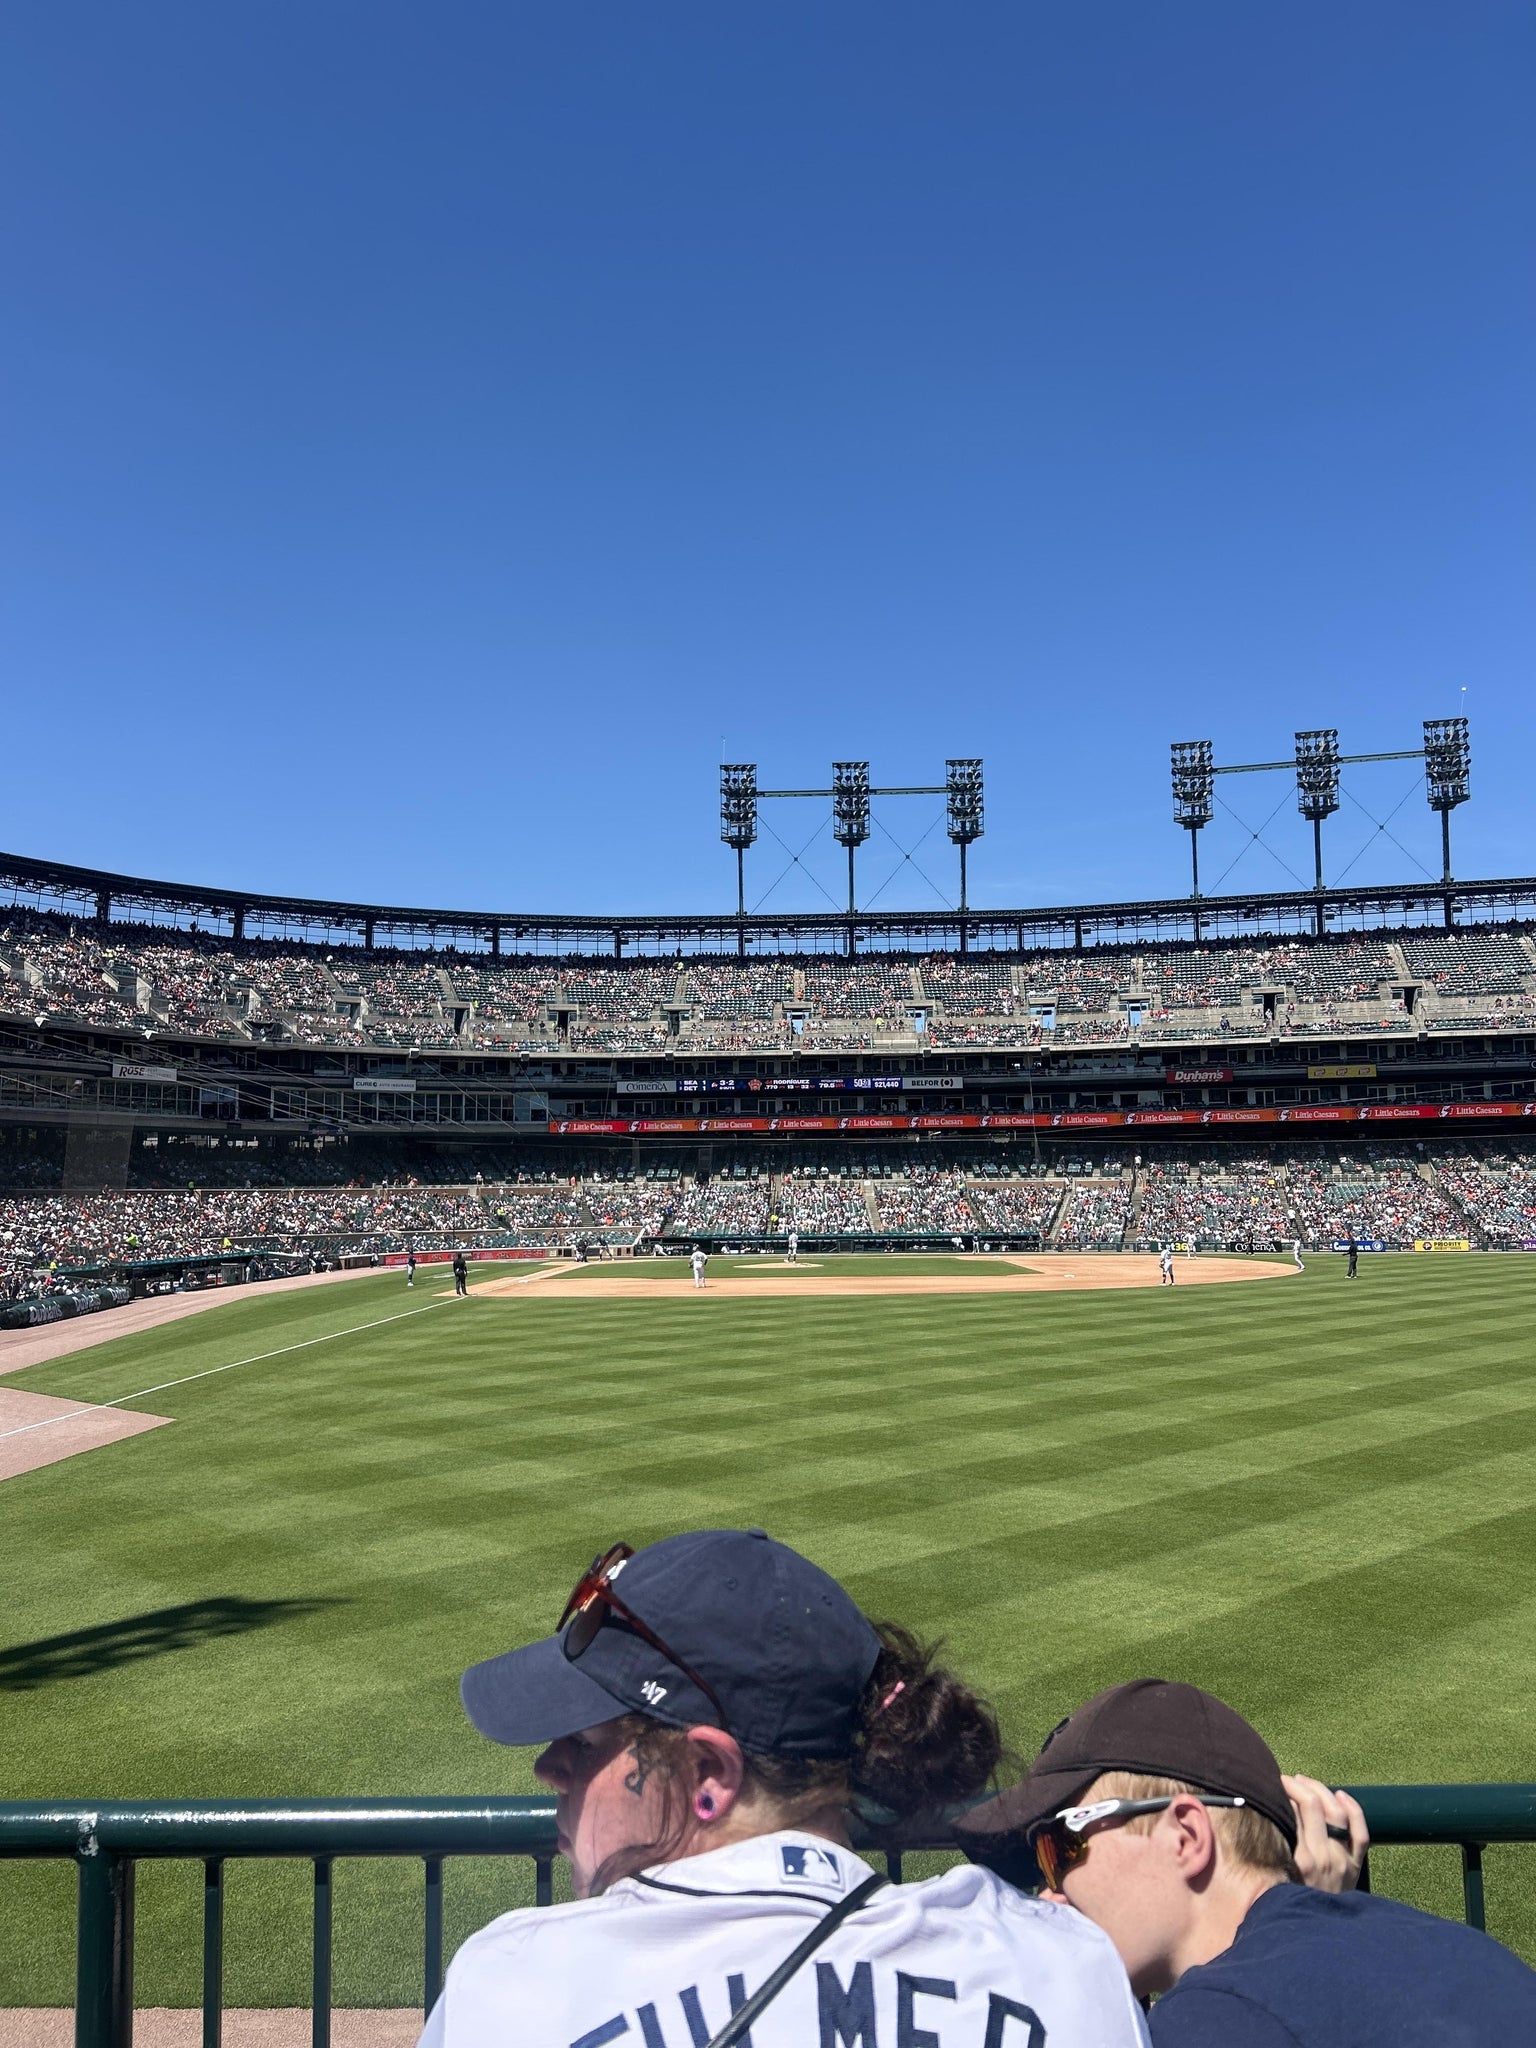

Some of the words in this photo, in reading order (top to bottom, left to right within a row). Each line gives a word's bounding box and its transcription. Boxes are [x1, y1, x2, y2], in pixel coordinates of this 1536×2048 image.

[119, 1066, 145, 1077] ROSE
[1174, 1069, 1224, 1081] Dunham's
[1374, 1109, 1393, 1117] Little
[1393, 1109, 1420, 1117] Caesars
[1456, 1106, 1474, 1114] Little
[1475, 1106, 1502, 1114] Caesars
[1141, 1114, 1157, 1122] Little
[1158, 1114, 1183, 1122] Caesars
[1295, 1111, 1312, 1119] Little
[1313, 1111, 1339, 1119] Caesars
[713, 1121, 729, 1129] Little
[730, 1121, 753, 1129] Caesars
[783, 1120, 799, 1128] Little
[800, 1120, 822, 1128] Caesars
[854, 1119, 869, 1127] Little
[870, 1119, 893, 1127] Caesars
[924, 1118, 939, 1126] Little
[940, 1118, 963, 1126] Caesars
[995, 1117, 1010, 1125] Little
[1011, 1117, 1034, 1125] Caesars
[573, 1123, 589, 1131] Little
[591, 1123, 613, 1131] Caesars
[644, 1122, 659, 1130] Little
[661, 1122, 683, 1130] Caesars
